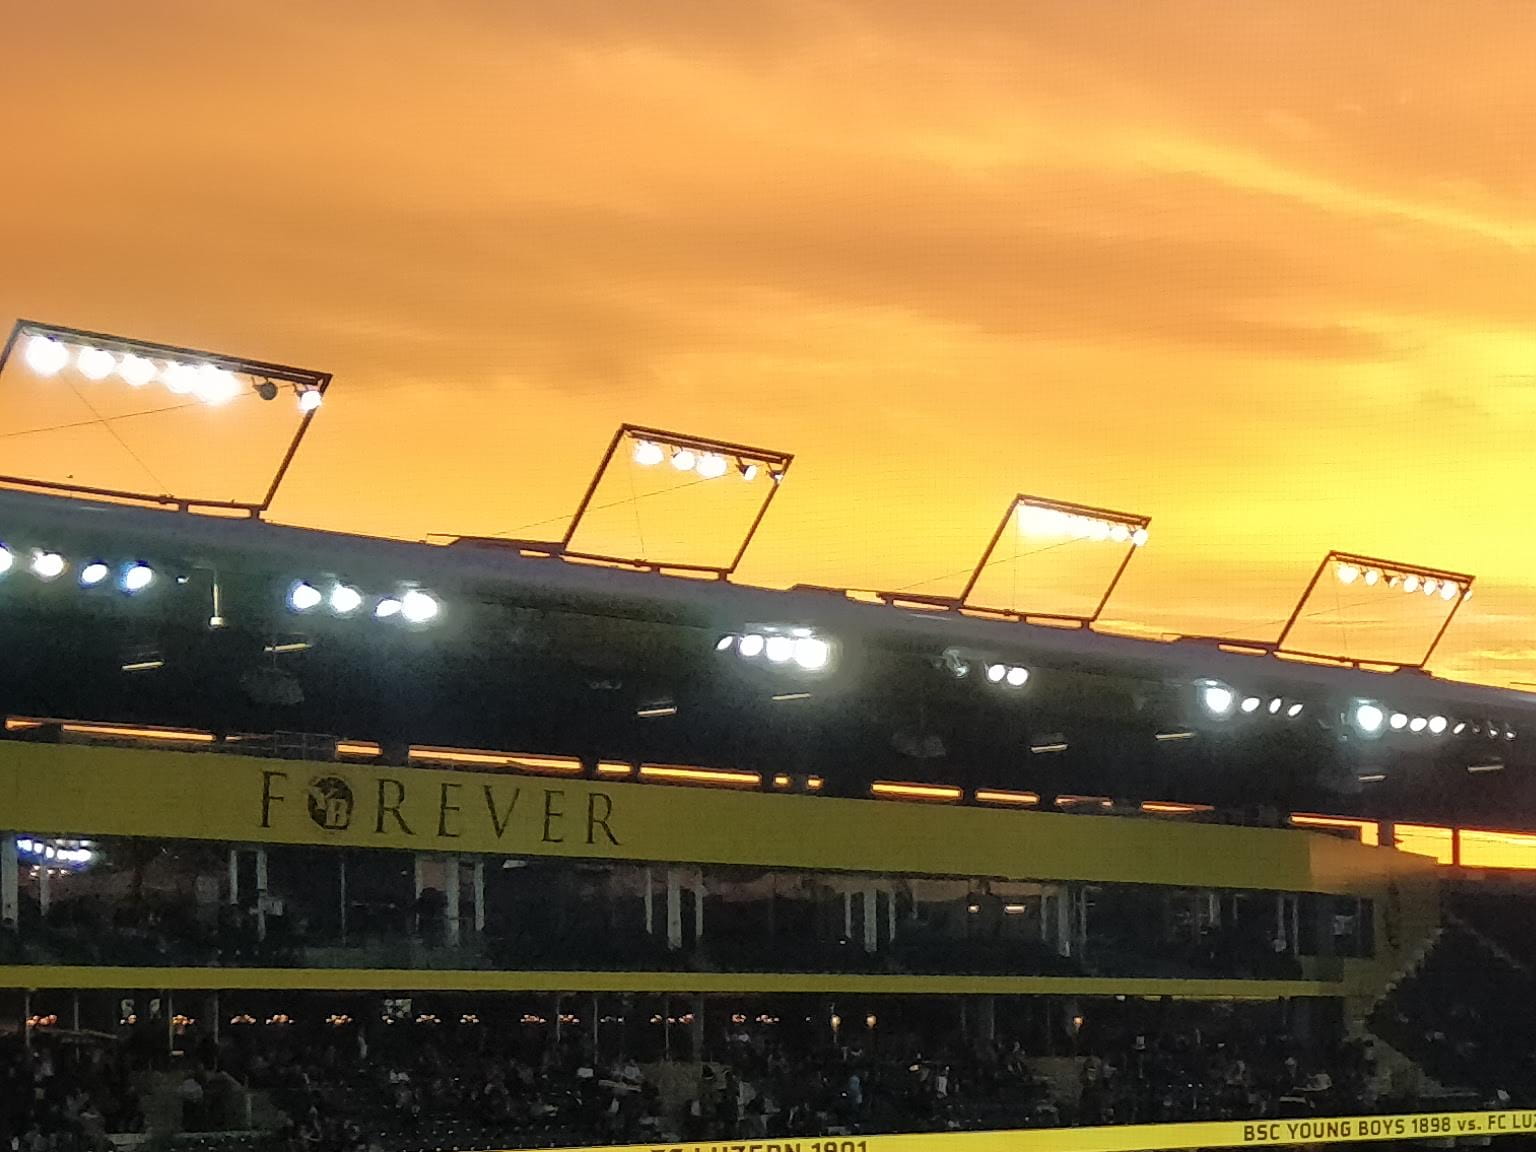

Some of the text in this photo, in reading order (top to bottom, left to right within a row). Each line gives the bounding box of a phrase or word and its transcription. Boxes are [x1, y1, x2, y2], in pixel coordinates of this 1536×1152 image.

[1243, 1123, 1281, 1142] BSC
[1287, 1120, 1352, 1140] YOUNG
[1358, 1118, 1405, 1137] BOYS
[1412, 1116, 1451, 1134] 1898
[1457, 1118, 1481, 1132] vs.
[1487, 1113, 1507, 1130] FC
